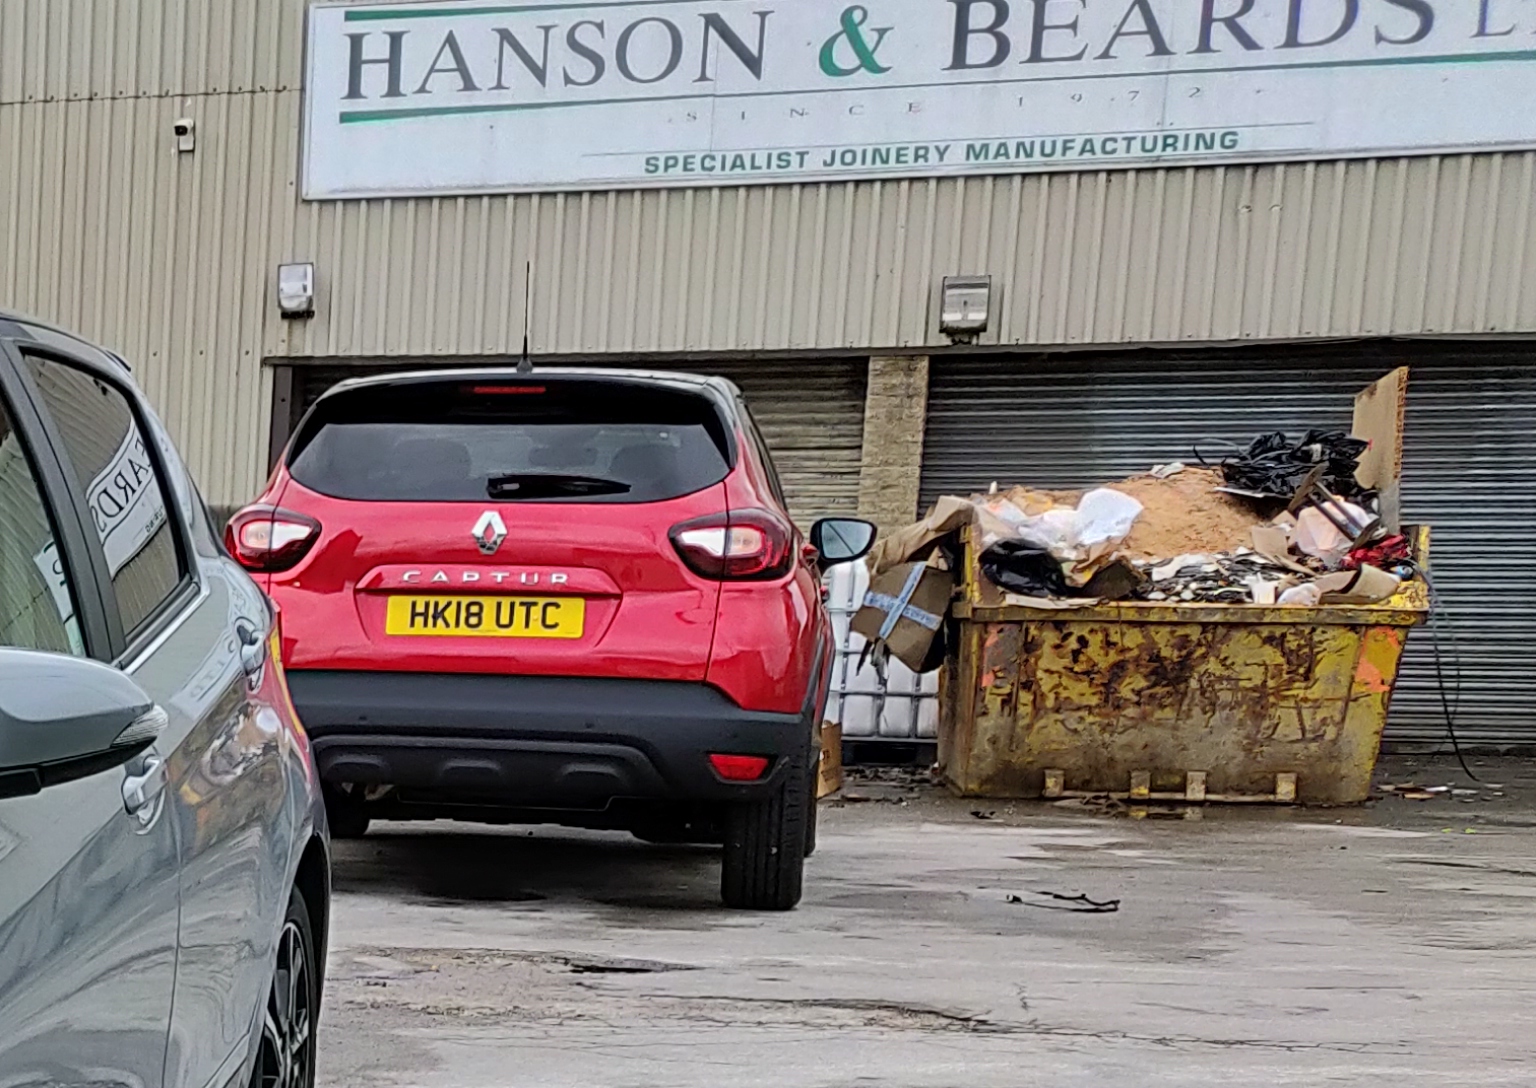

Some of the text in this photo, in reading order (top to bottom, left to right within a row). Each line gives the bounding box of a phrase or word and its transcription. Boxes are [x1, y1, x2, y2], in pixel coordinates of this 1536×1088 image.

[341, 9, 775, 100] HANSON
[819, 5, 896, 78] &
[940, 0, 1435, 72] BEARDS
[644, 131, 1240, 174] SPECIALIST JOINERY MANUFACTURING
[402, 570, 569, 585] CAPTUR
[409, 600, 562, 629] HK18 UTC
